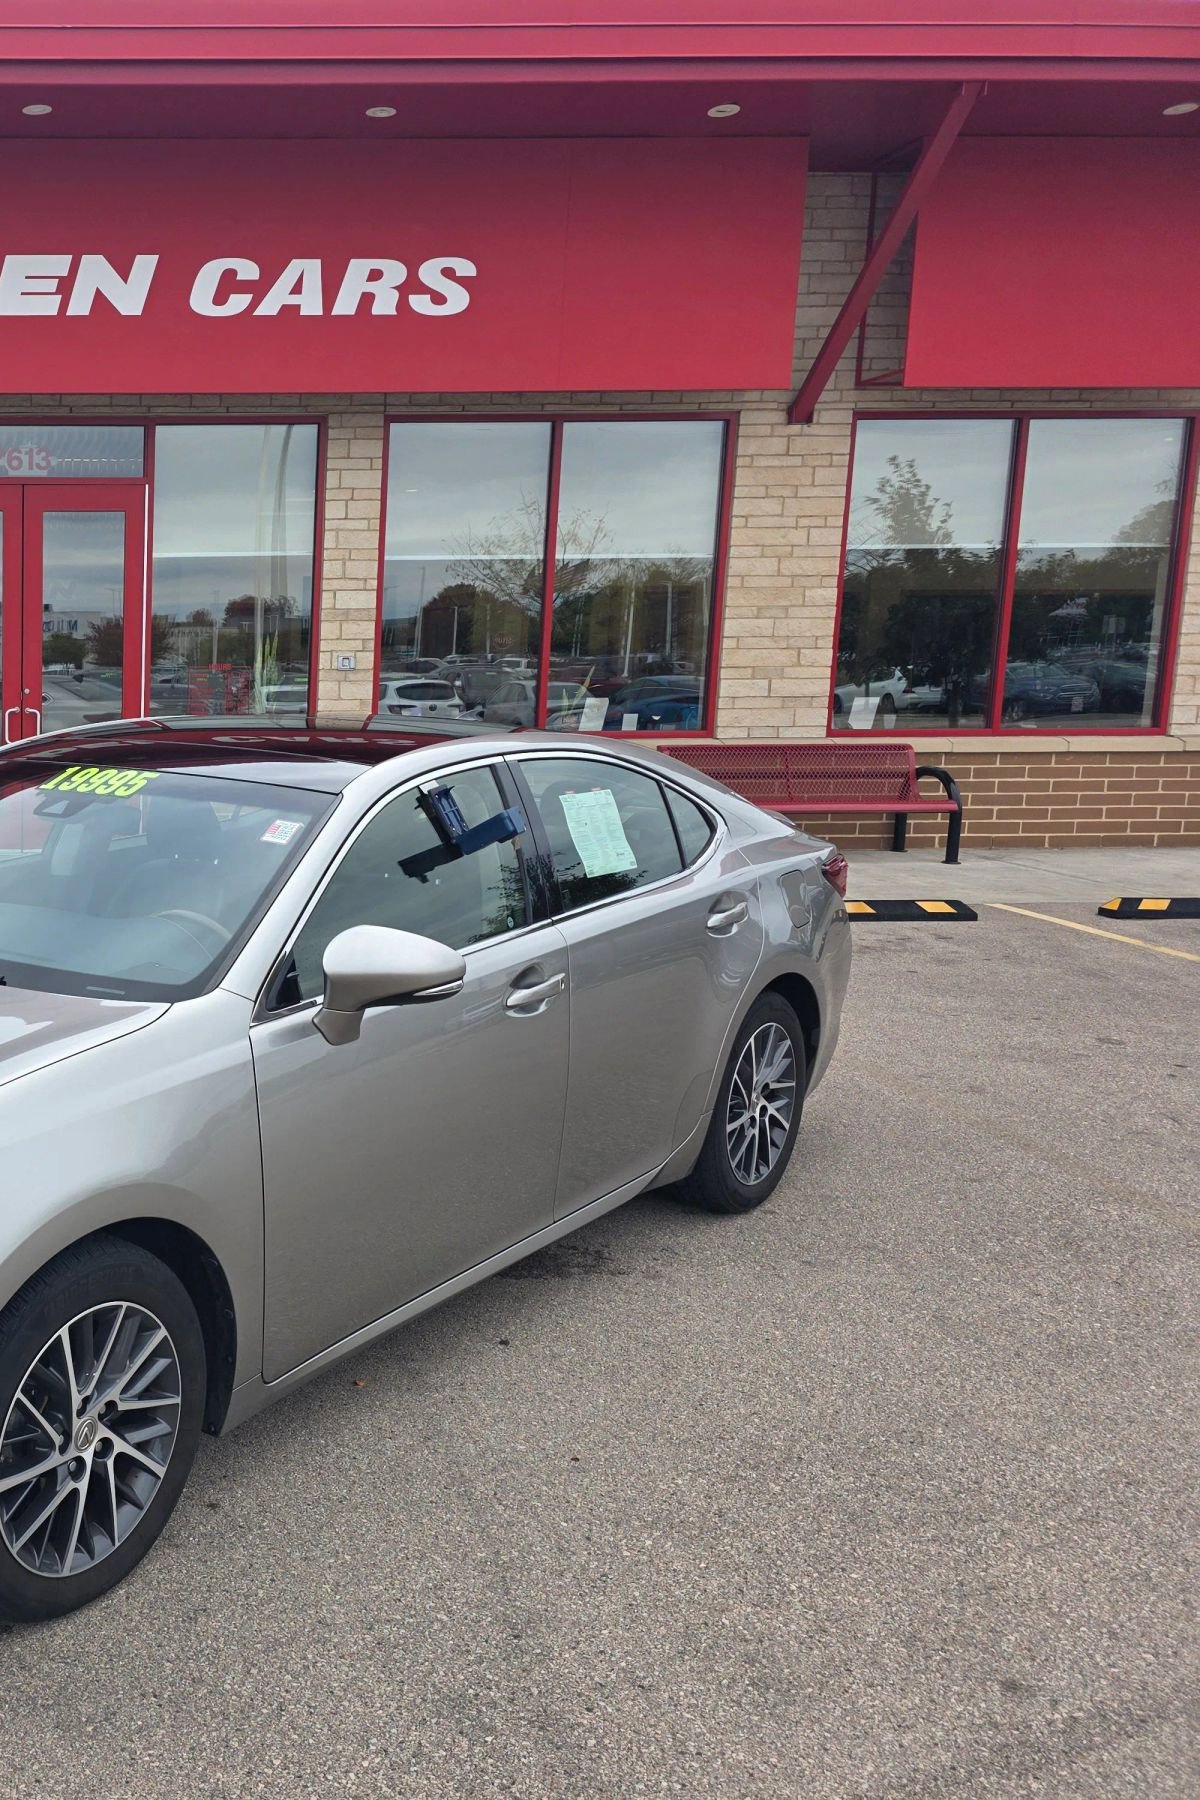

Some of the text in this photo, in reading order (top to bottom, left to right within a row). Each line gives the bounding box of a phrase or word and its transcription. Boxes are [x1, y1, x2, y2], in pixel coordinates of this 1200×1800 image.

[188, 256, 479, 317] CARS
[208, 663, 233, 671] HOURS
[39, 766, 161, 797] 19995
